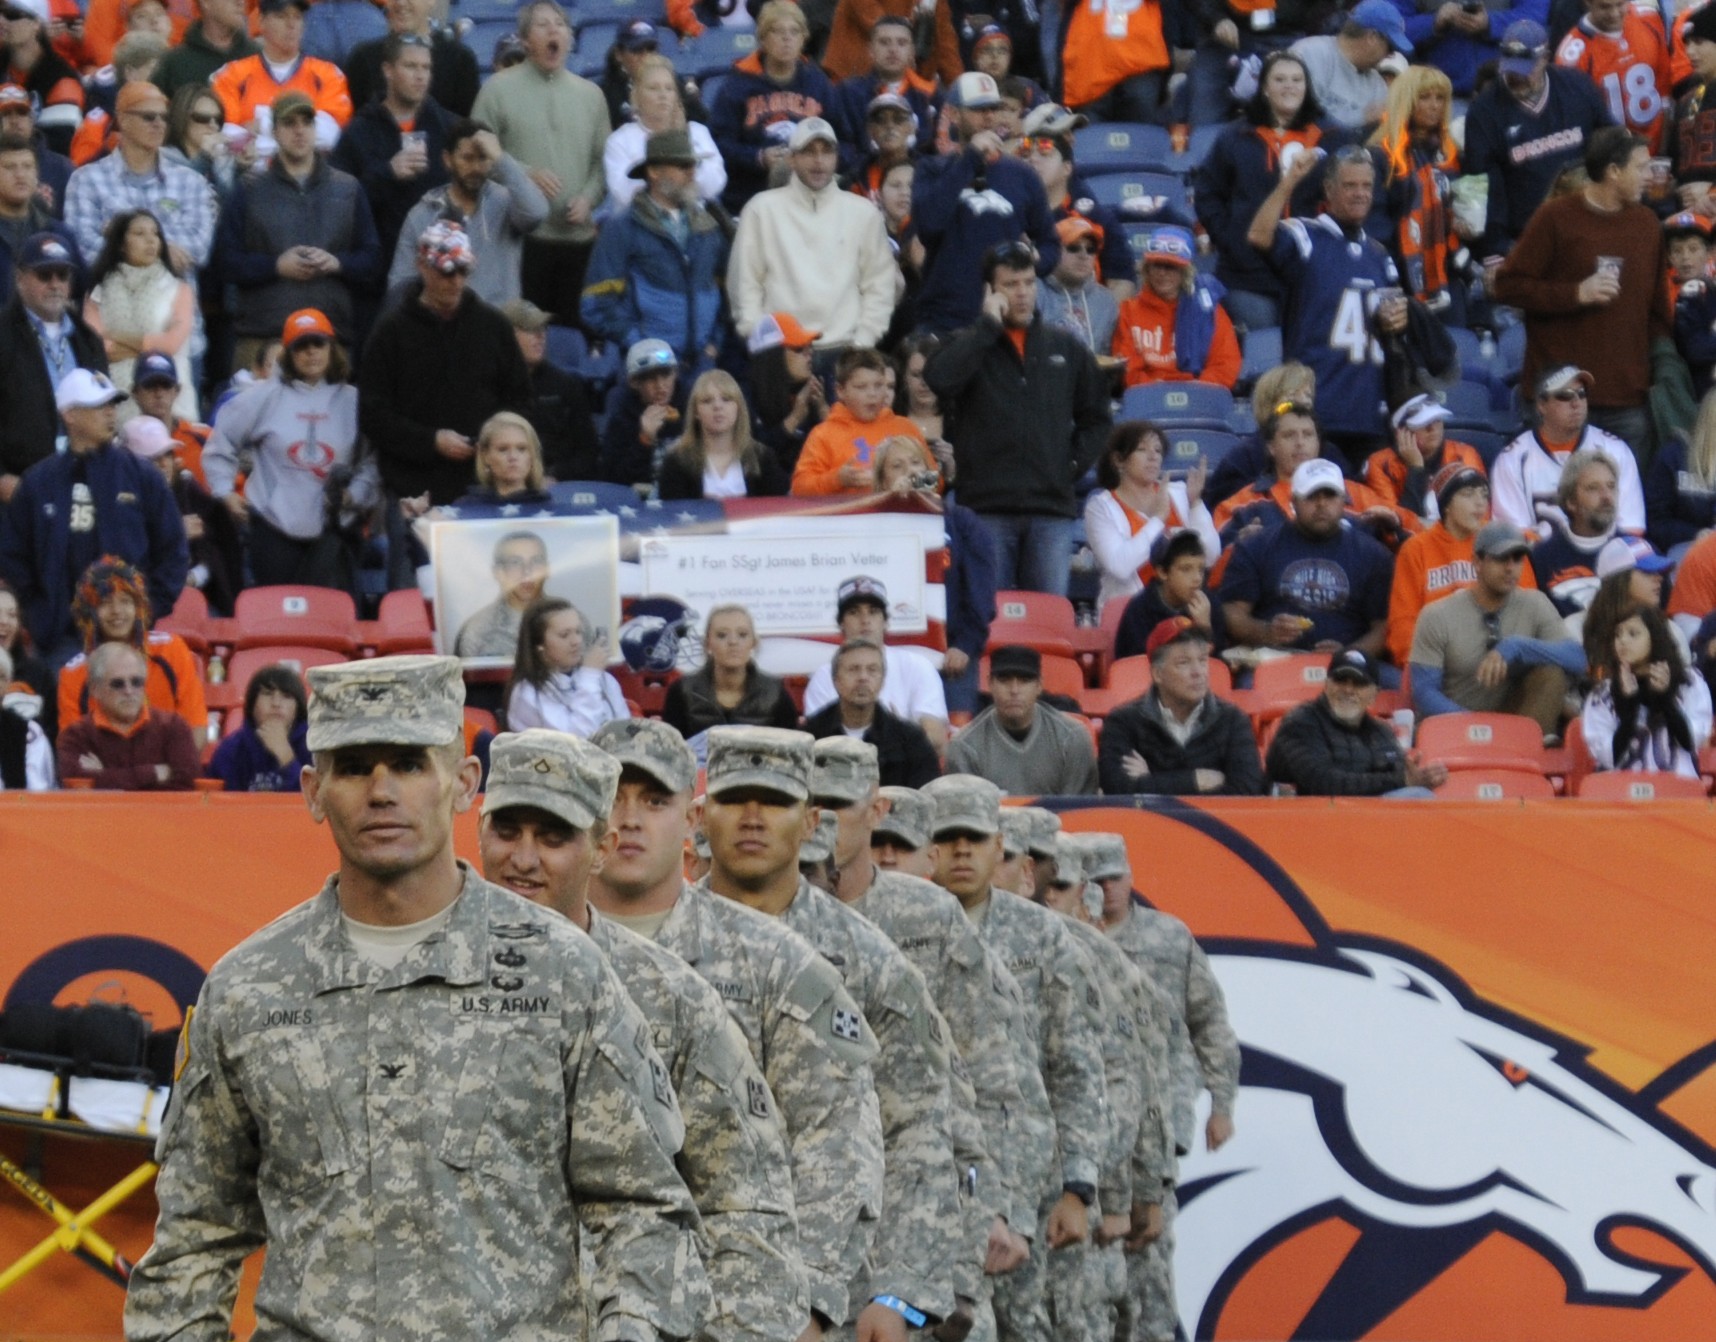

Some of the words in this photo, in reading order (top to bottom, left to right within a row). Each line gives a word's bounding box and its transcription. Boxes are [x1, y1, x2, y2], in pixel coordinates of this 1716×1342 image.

[1603, 62, 1662, 126] 18
[1512, 126, 1583, 163] BRONCOS
[678, 556, 696, 570] #1
[702, 555, 727, 569] Fan
[731, 554, 762, 571] SSgt
[765, 554, 806, 568] James
[811, 553, 846, 567] Brian
[714, 981, 743, 997] RMY
[462, 998, 494, 1013] U.S.
[500, 997, 550, 1014] ARMY
[262, 1009, 313, 1027] JONES
